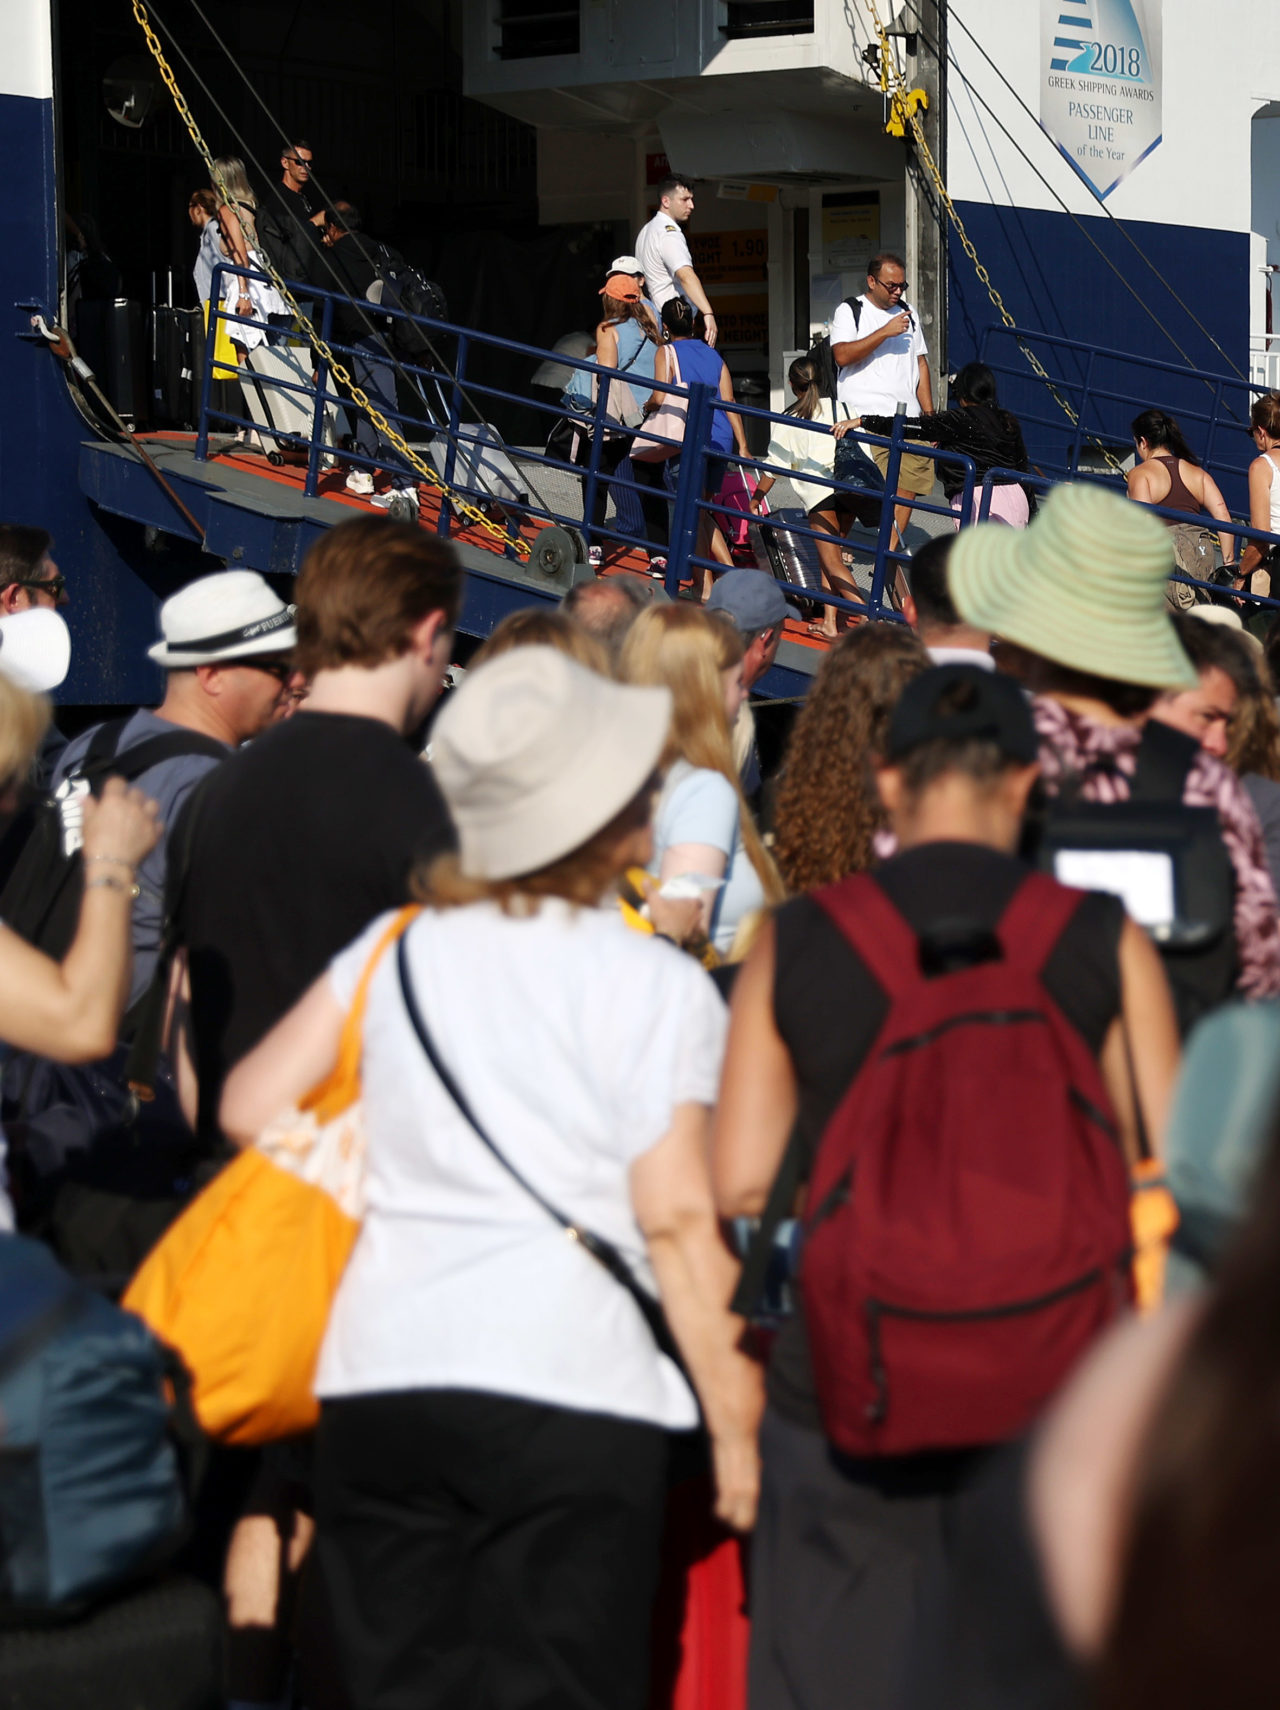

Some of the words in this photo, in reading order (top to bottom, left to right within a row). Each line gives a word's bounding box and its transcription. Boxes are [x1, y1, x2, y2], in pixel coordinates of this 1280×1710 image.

[1090, 42, 1140, 77] 2018
[1048, 76, 1076, 91] GREEK
[1078, 81, 1117, 97] SHIPPING
[1120, 86, 1154, 102] AWARDS
[1069, 101, 1133, 125] PASSENGER
[1088, 125, 1114, 142] LINE
[1077, 145, 1087, 156] of
[1089, 145, 1104, 159] the
[1106, 148, 1125, 161] Year
